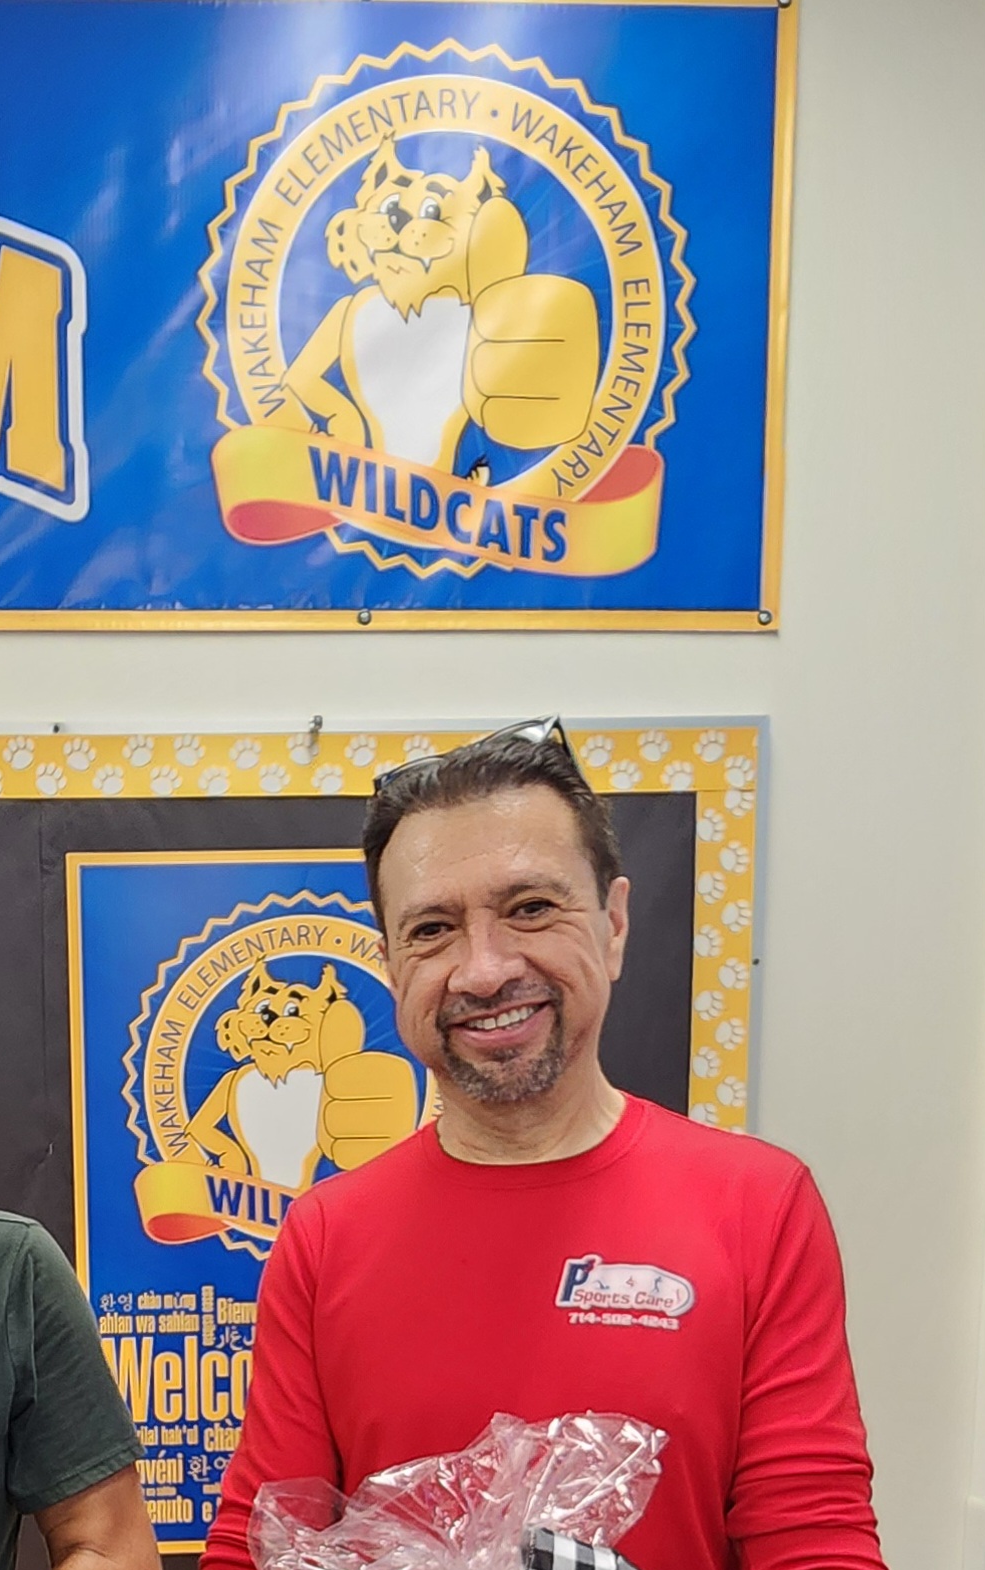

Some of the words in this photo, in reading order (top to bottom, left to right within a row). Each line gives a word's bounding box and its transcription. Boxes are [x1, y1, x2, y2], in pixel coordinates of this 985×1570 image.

[274, 88, 481, 208] ELEMENTARY
[509, 101, 644, 258] WAKEHAM
[240, 219, 284, 419] WAKEHAM
[553, 276, 652, 498] ELEMENTARY
[307, 444, 568, 563] WILDCATS
[154, 1019, 190, 1157] WAKEHAM
[176, 924, 329, 1011] ELEMENTARY
[573, 1289, 630, 1304] Sports
[634, 1291, 675, 1308] Care
